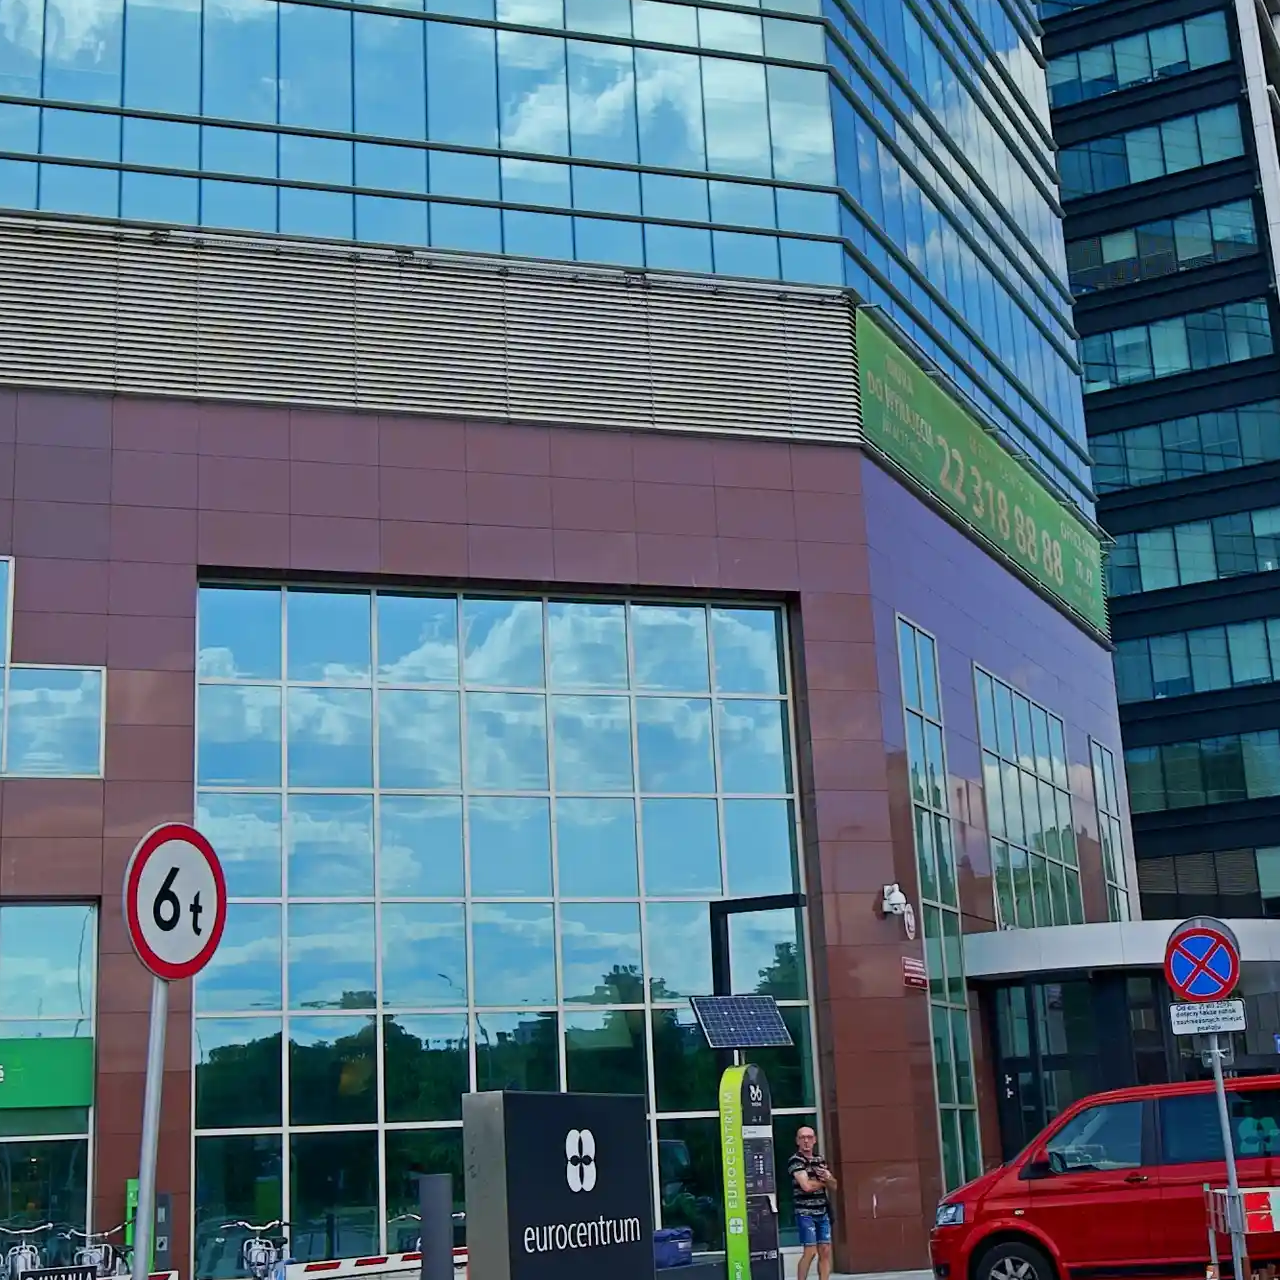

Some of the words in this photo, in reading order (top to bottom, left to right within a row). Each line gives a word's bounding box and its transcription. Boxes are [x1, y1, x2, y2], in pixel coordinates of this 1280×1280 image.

[937, 434, 966, 505] 22
[970, 466, 1010, 541] 318
[1014, 505, 1038, 565] 88
[1042, 530, 1064, 587] 88
[724, 1091, 739, 1209] EUROCENTRUM
[523, 1215, 641, 1253] eurocentrum
